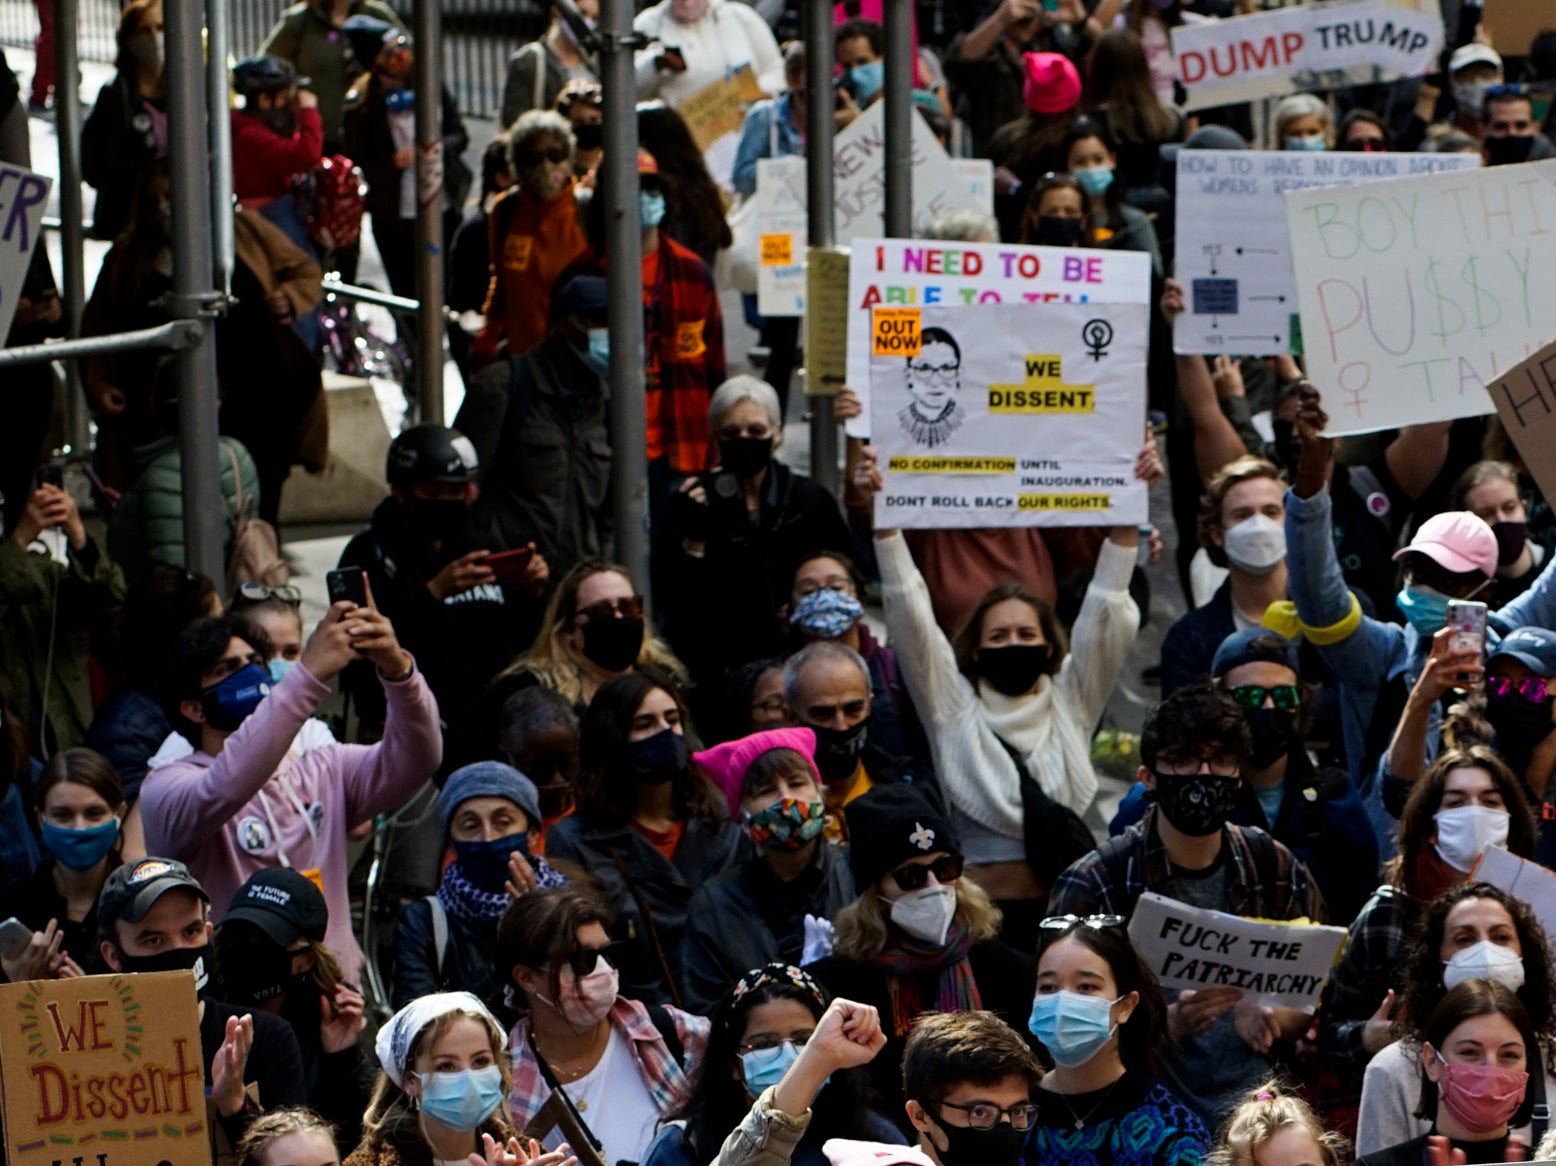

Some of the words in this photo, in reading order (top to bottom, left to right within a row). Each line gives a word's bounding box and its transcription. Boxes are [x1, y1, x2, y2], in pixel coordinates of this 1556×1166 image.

[1179, 32, 1304, 84] DUMP
[1315, 19, 1429, 54] TRUMP
[1180, 158, 1218, 174] HOW
[1229, 157, 1250, 173] TO
[1313, 156, 1335, 175] AN
[1340, 157, 1398, 176] OPINION
[1303, 193, 1418, 259] BOY
[876, 246, 884, 272] I
[903, 248, 983, 276] NEED
[1000, 252, 1040, 278] TO
[1063, 256, 1103, 283] BE
[1317, 247, 1530, 363] PU$$Y
[879, 320, 916, 335] OUT
[875, 334, 920, 351] NOW
[1025, 360, 1062, 377] WE
[889, 459, 909, 470] NO
[912, 459, 1016, 470] CONFIRMATION
[1021, 459, 1061, 470] UNTIL
[1021, 477, 1128, 488] INAUGURATION.
[886, 496, 925, 507] DONT
[931, 496, 970, 508] ROLL
[974, 496, 1014, 508] BACK
[1018, 497, 1049, 508] OUR
[1054, 497, 1115, 508] RIGHTS.
[256, 893, 286, 906] FEMALE
[264, 886, 291, 901] FUTURE
[1159, 917, 1240, 955] FUCK
[1248, 940, 1302, 961] THE
[1160, 952, 1323, 996] PATRIARCHY
[253, 984, 283, 1000] VOTE
[47, 1000, 113, 1052] WE
[31, 1038, 200, 1126] Dissent
